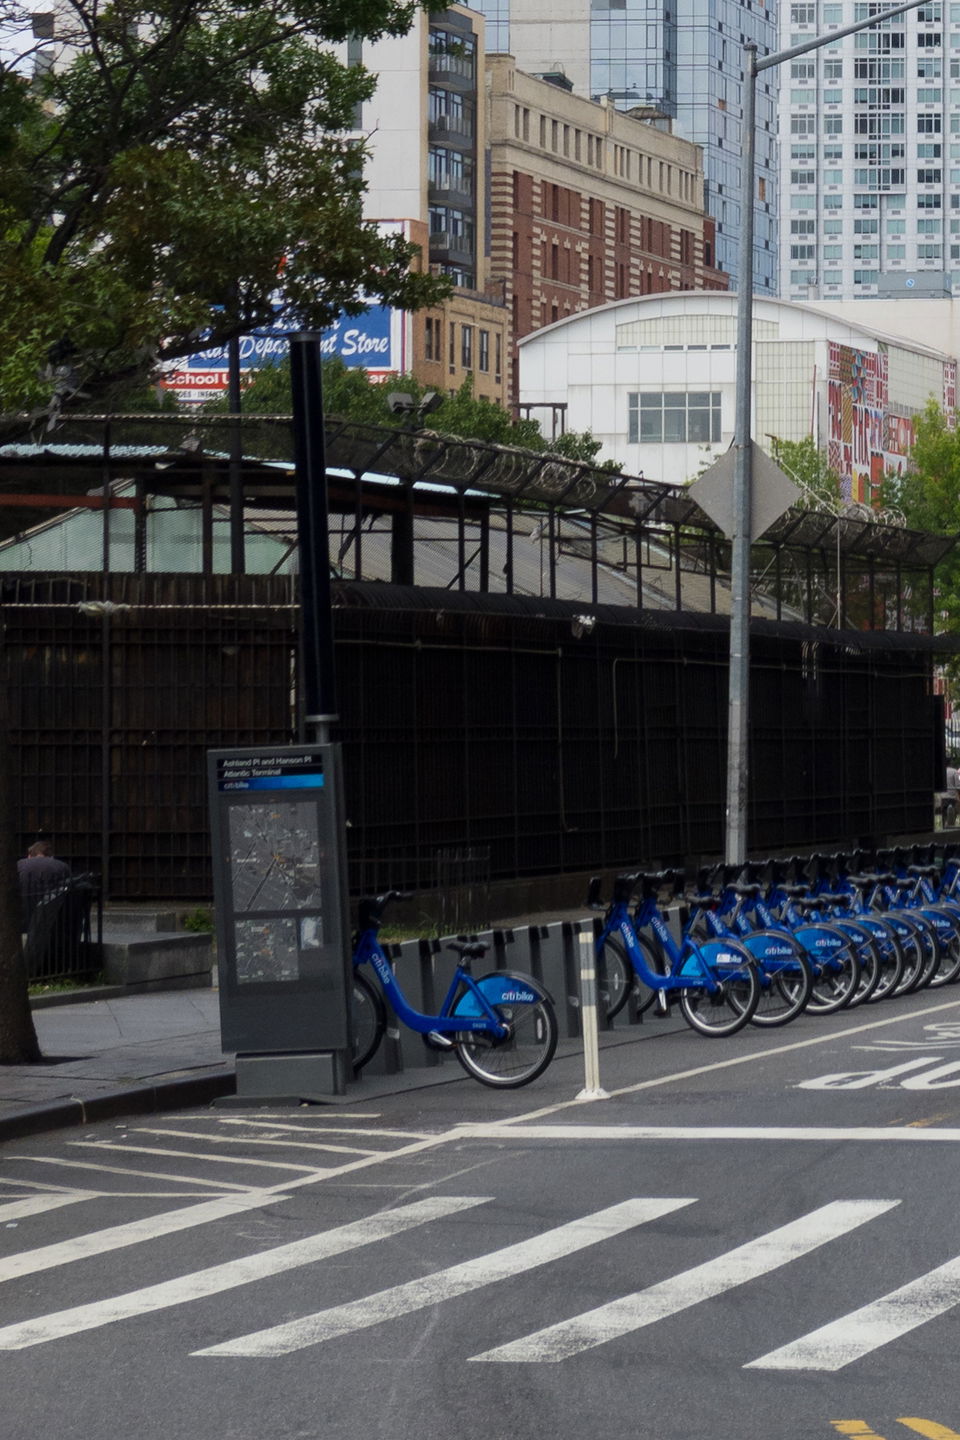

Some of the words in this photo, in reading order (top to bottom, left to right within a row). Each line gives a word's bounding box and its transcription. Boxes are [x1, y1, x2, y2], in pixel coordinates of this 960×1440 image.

[239, 334, 337, 359] Deparnt
[342, 330, 389, 355] Store
[165, 373, 219, 384] School
[261, 757, 275, 766] and
[223, 769, 251, 778] Atlantic
[252, 768, 281, 777] Terminal
